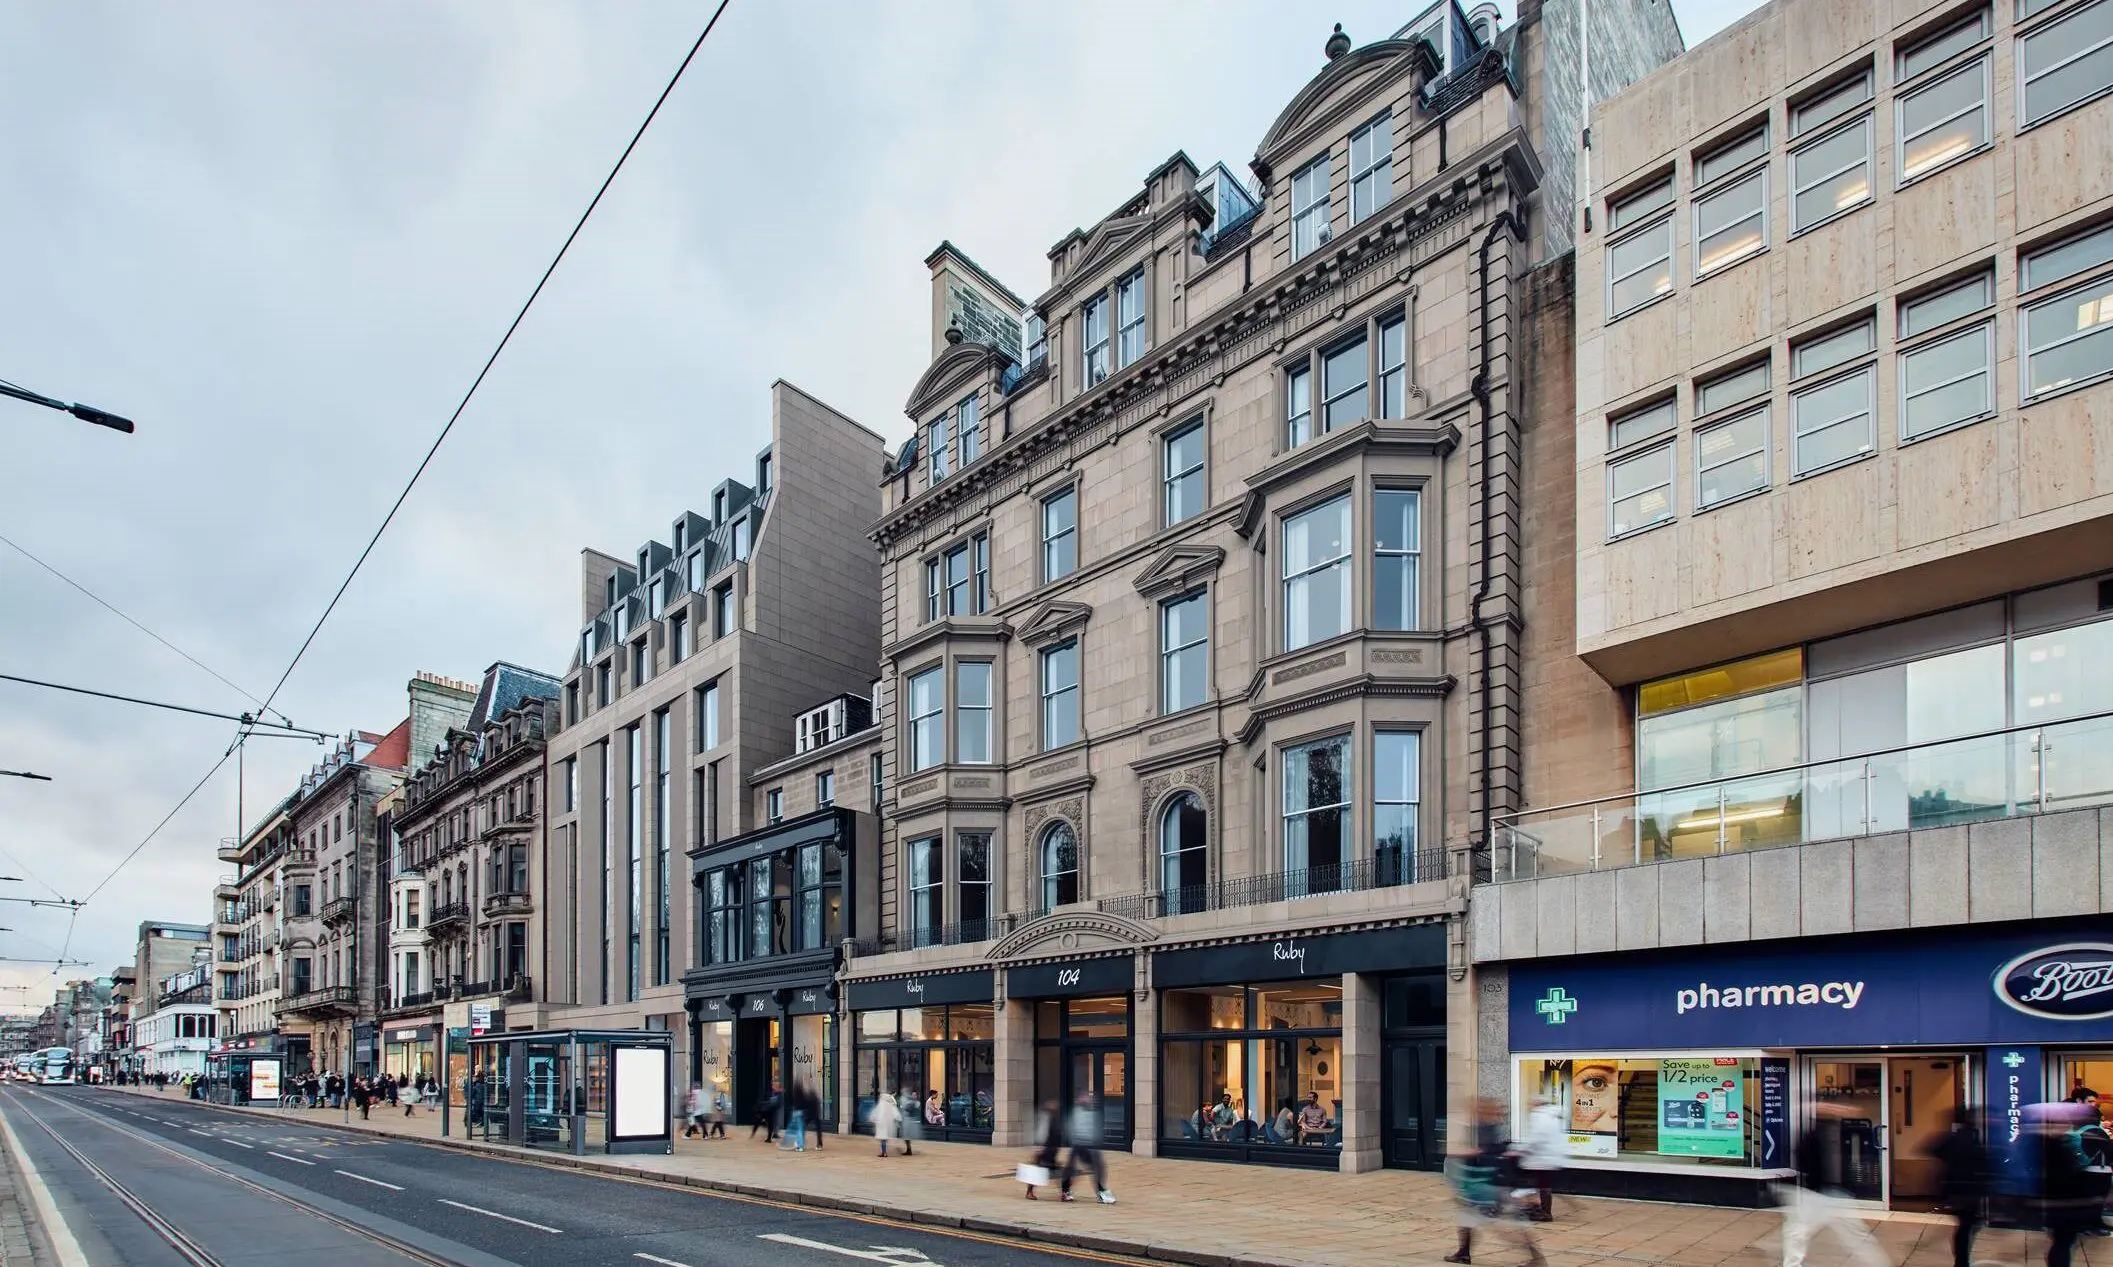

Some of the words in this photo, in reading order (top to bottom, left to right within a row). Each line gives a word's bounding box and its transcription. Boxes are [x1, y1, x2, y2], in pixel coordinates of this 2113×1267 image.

[1274, 940, 1305, 974] Ruby
[1057, 968, 1081, 986] 104
[1484, 984, 1502, 993] 103
[2020, 962, 2113, 1001] Boot
[802, 989, 816, 1011] Ruby
[907, 979, 924, 1003] Ruby
[1677, 981, 1864, 1015] pharmacy
[709, 1000, 720, 1019] Ruby
[752, 1000, 765, 1011] 106
[703, 1048, 719, 1078] Ruby
[794, 1046, 813, 1078] Ruby
[1663, 1060, 1690, 1069] Save
[1663, 1070, 1687, 1083] 1/2
[1690, 1074, 1718, 1085] price
[2008, 1075, 2021, 1143] pharmacy
